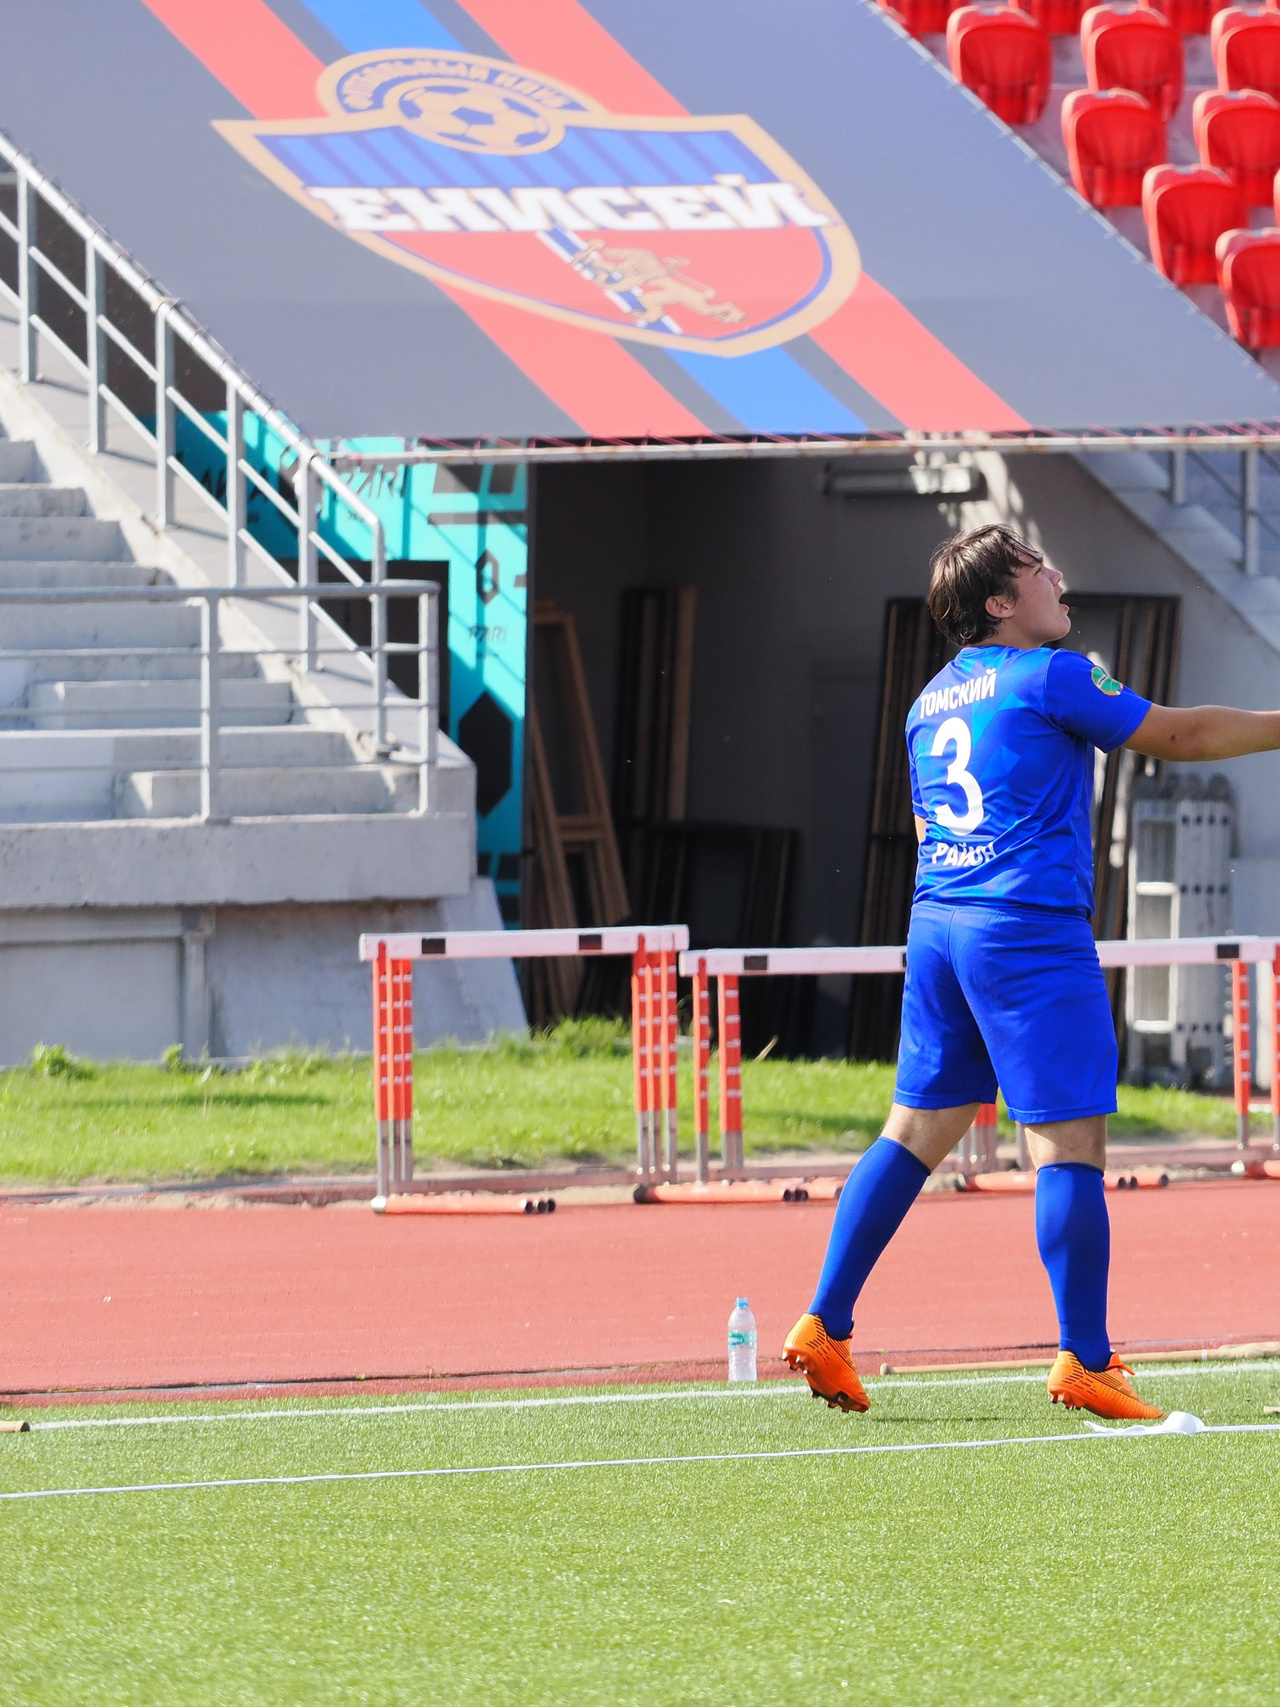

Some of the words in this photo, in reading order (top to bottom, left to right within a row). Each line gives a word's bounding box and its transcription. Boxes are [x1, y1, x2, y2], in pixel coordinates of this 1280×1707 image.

[307, 173, 829, 231] ЕНИСЕЙ
[919, 667, 998, 720] ТОМСКИЙ
[930, 716, 984, 836] 3
[931, 841, 998, 867] РАЙОН
